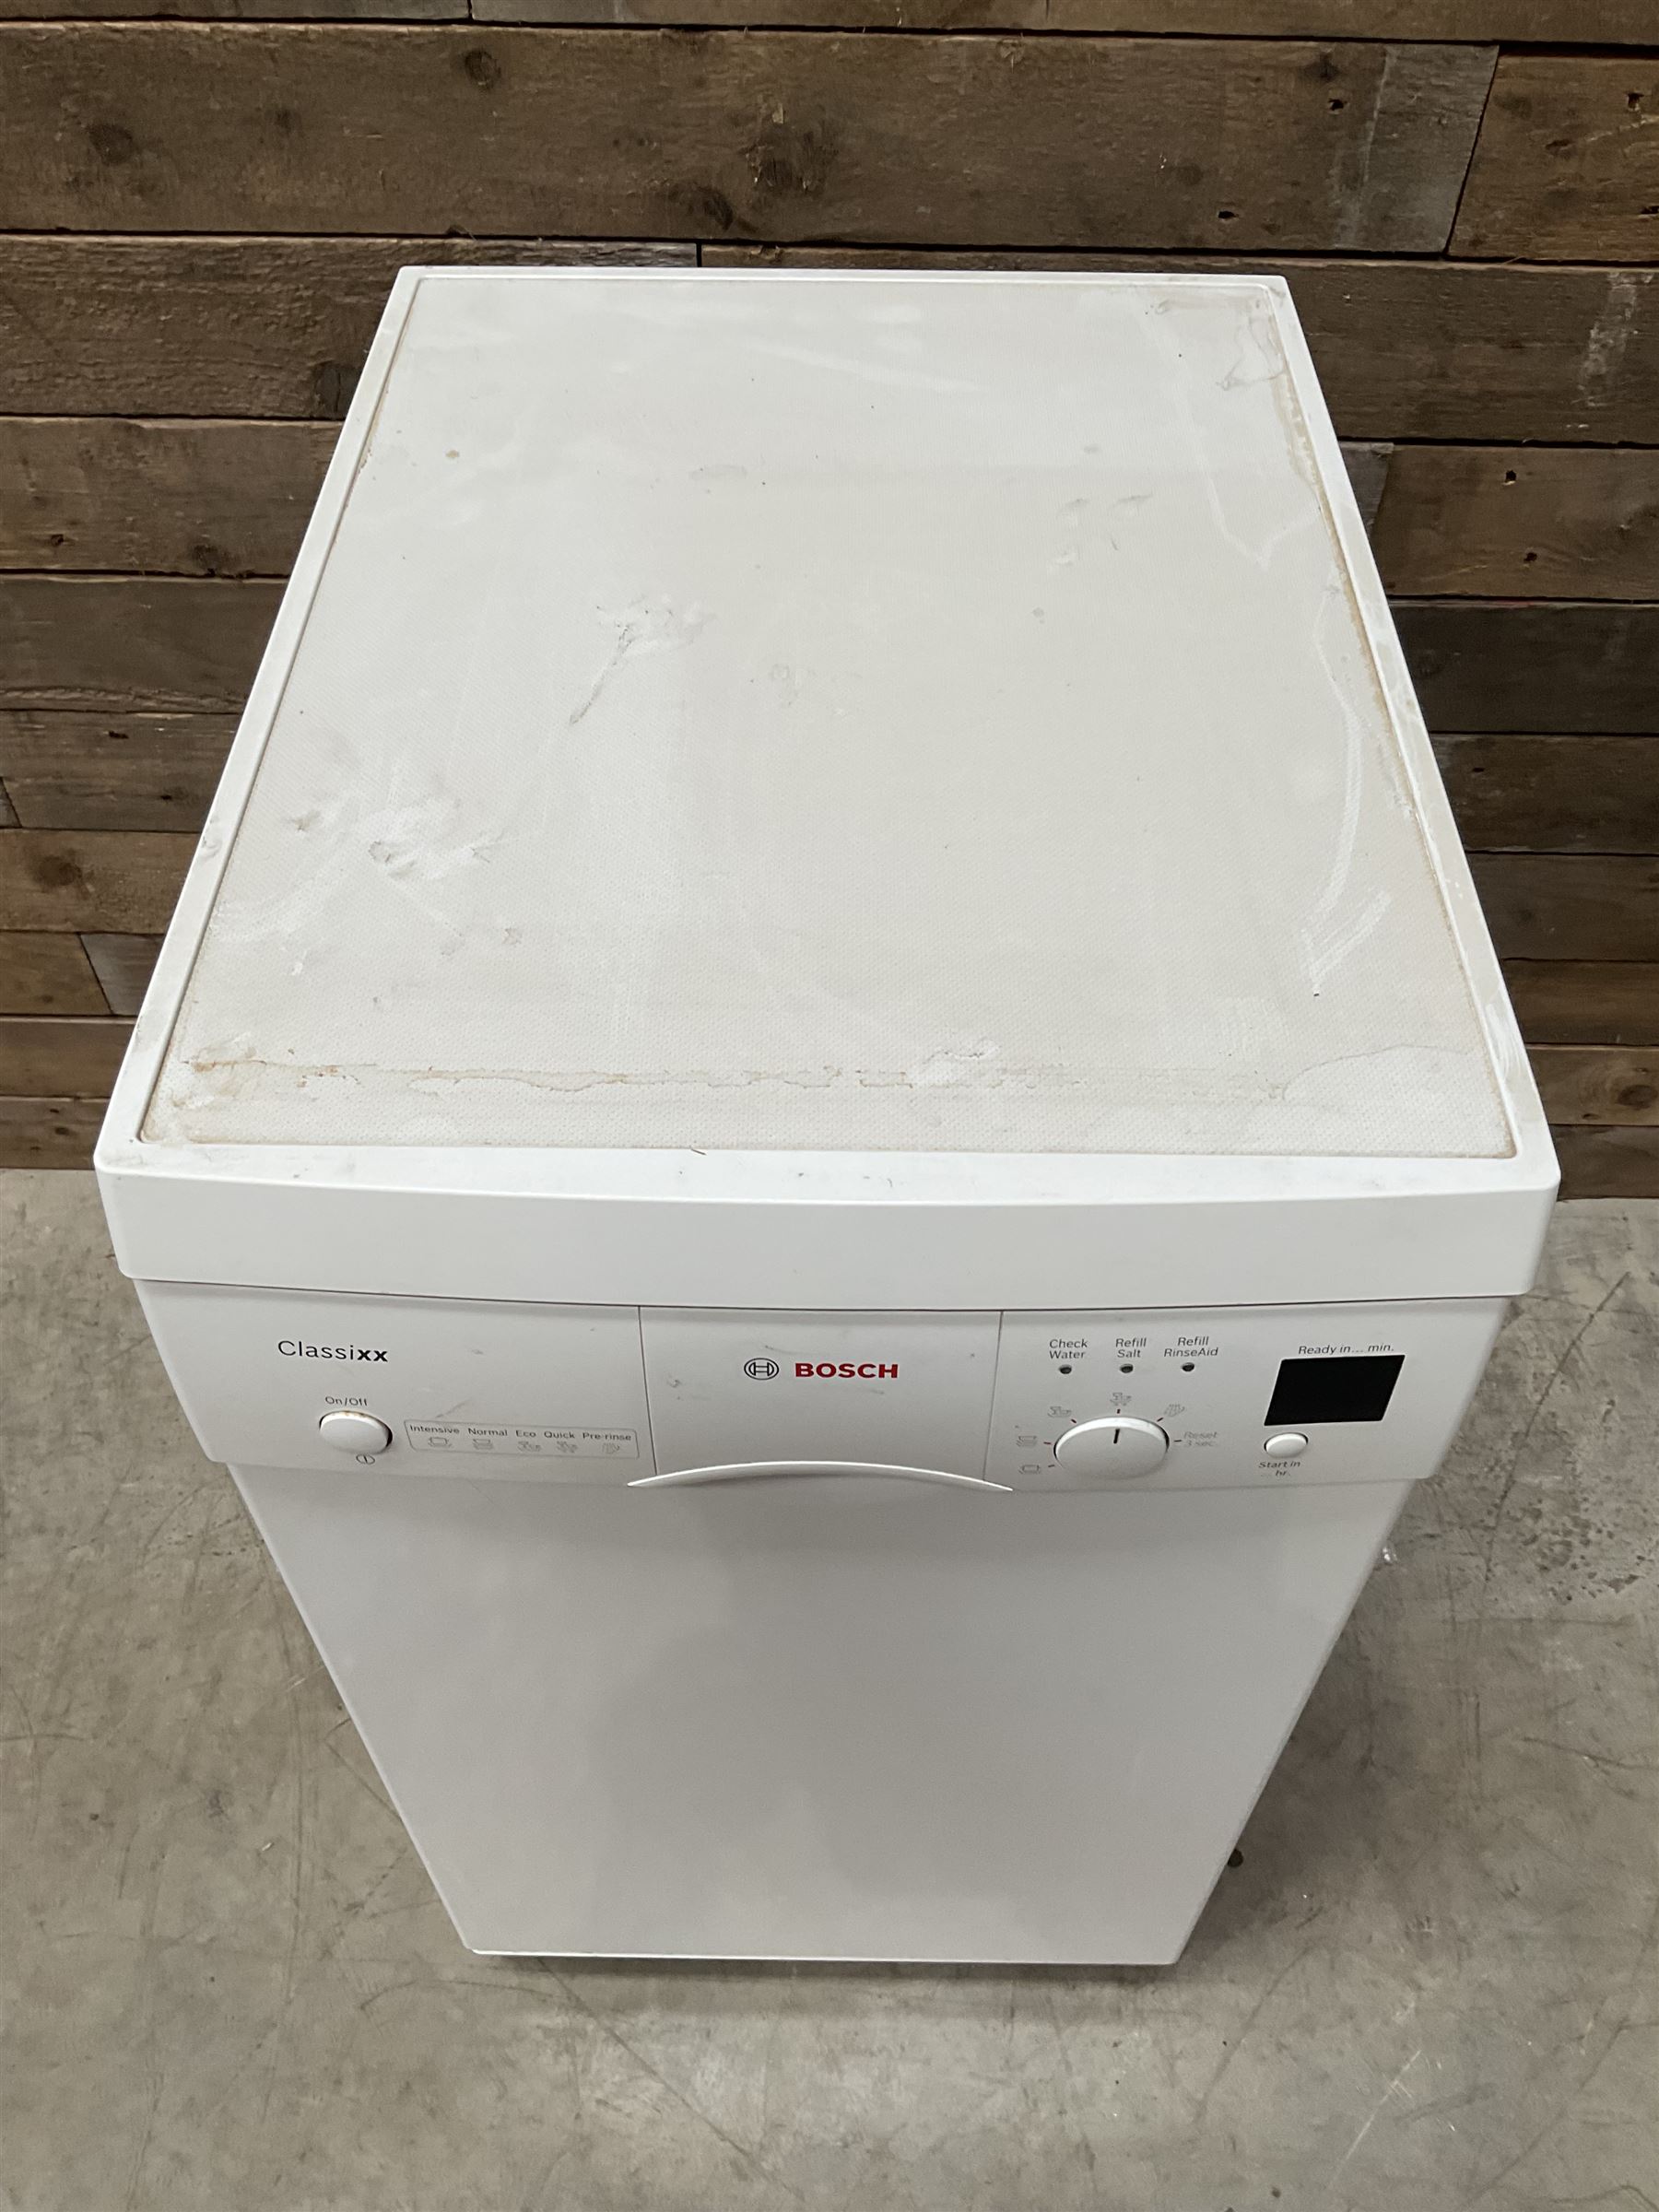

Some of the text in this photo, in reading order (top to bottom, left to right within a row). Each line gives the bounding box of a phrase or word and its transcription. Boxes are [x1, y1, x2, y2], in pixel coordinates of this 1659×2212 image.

[1049, 1338, 1088, 1348] Check
[1115, 1337, 1147, 1347] Refill
[1177, 1336, 1210, 1347] Refill
[277, 1340, 389, 1363] Classixx
[1049, 1349, 1087, 1359] Water
[1117, 1348, 1142, 1359] Salt
[1163, 1347, 1219, 1358] RinseAid
[1298, 1345, 1337, 1355] Ready
[1368, 1344, 1394, 1353] min.
[794, 1362, 899, 1379] BOSCH
[324, 1395, 369, 1406] On/Off
[409, 1424, 461, 1434] Intensive
[467, 1427, 509, 1437] Normal
[515, 1430, 537, 1438] Eco
[544, 1430, 576, 1440] Quick
